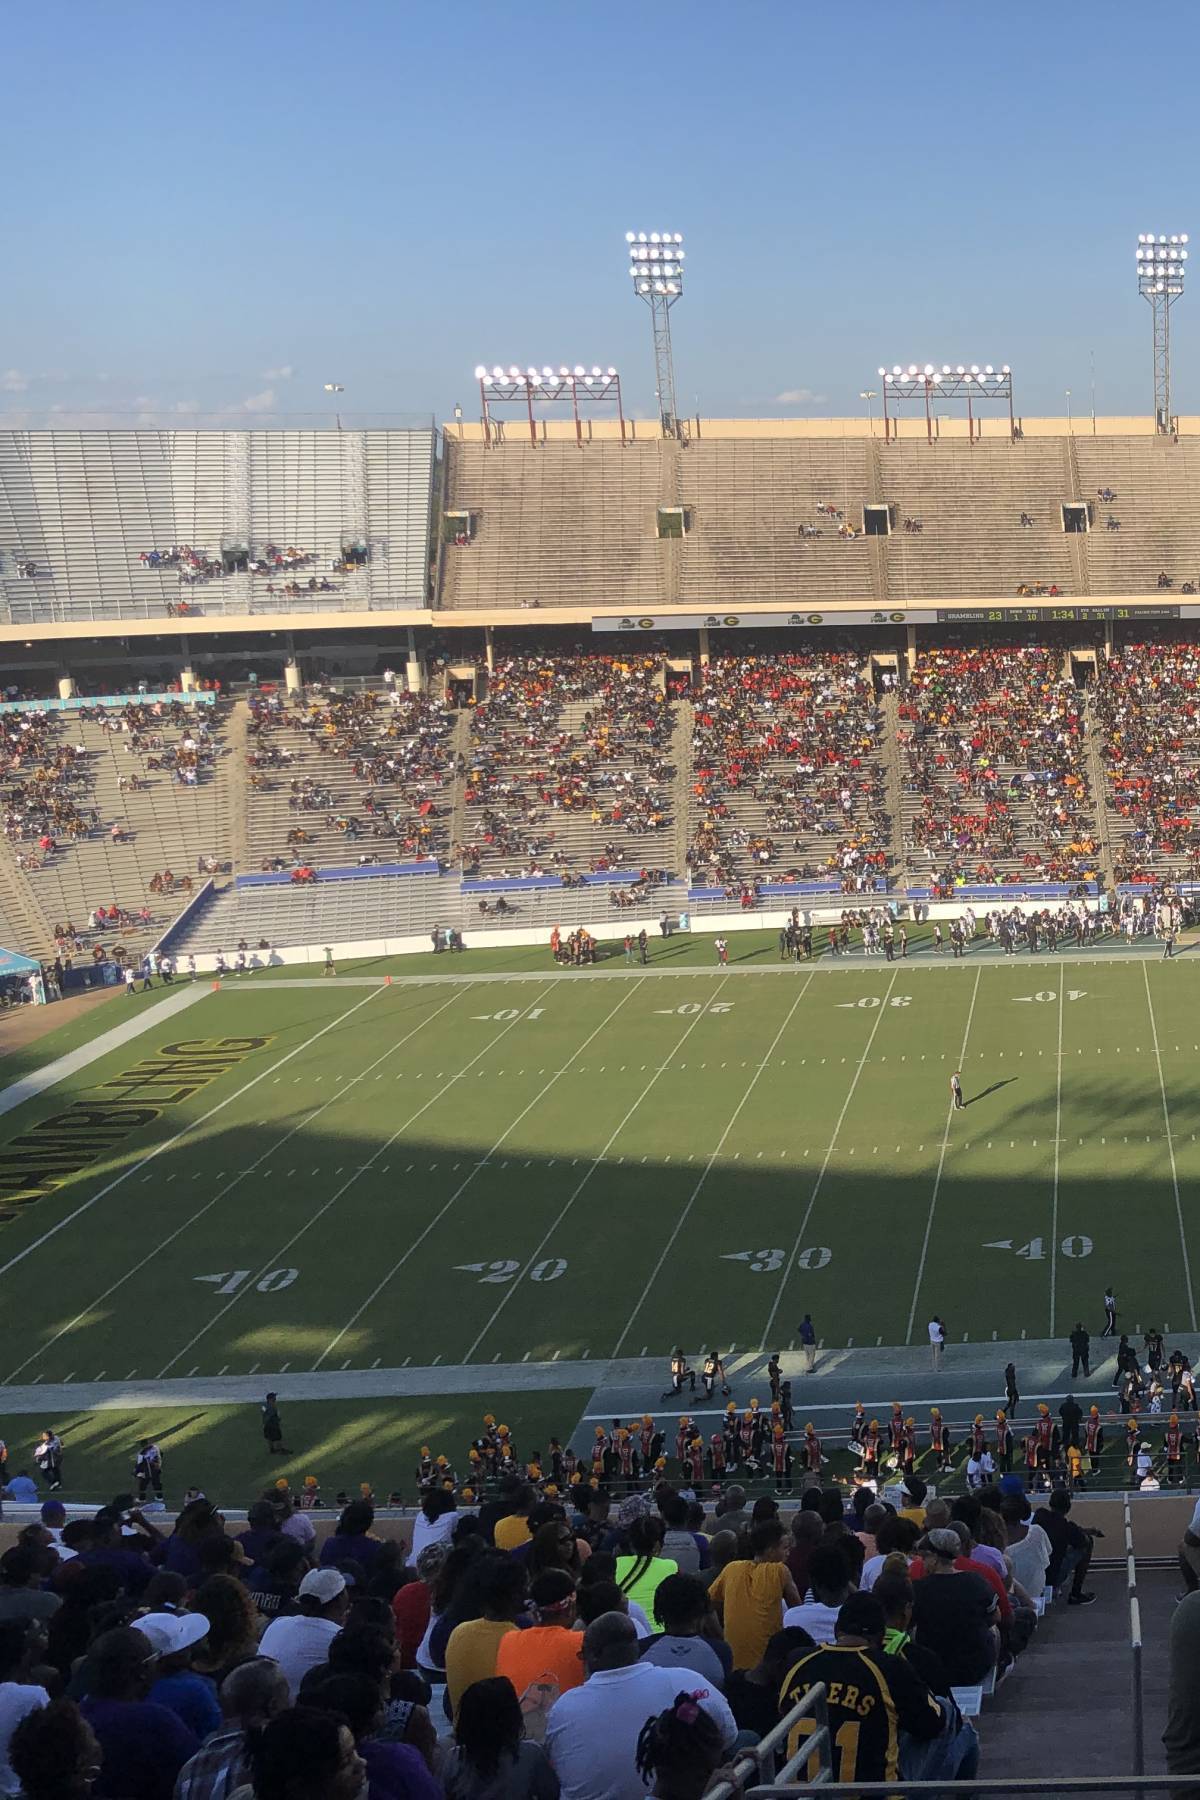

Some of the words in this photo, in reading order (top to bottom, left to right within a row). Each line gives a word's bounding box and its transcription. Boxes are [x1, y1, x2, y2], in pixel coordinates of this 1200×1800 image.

[989, 611, 1001, 620] 23
[1052, 610, 1074, 620] 1:34
[1118, 609, 1130, 618] 31
[858, 996, 912, 1008] 30
[1035, 990, 1088, 1002] 40
[492, 1008, 546, 1020] 10
[677, 1002, 736, 1014] 20
[1015, 1236, 1093, 1260] 40
[750, 1247, 832, 1272] 30
[477, 1258, 568, 1283] 20
[214, 1268, 299, 1294] 10
[704, 1362, 714, 1373] 12
[790, 1682, 875, 1716] TIERS
